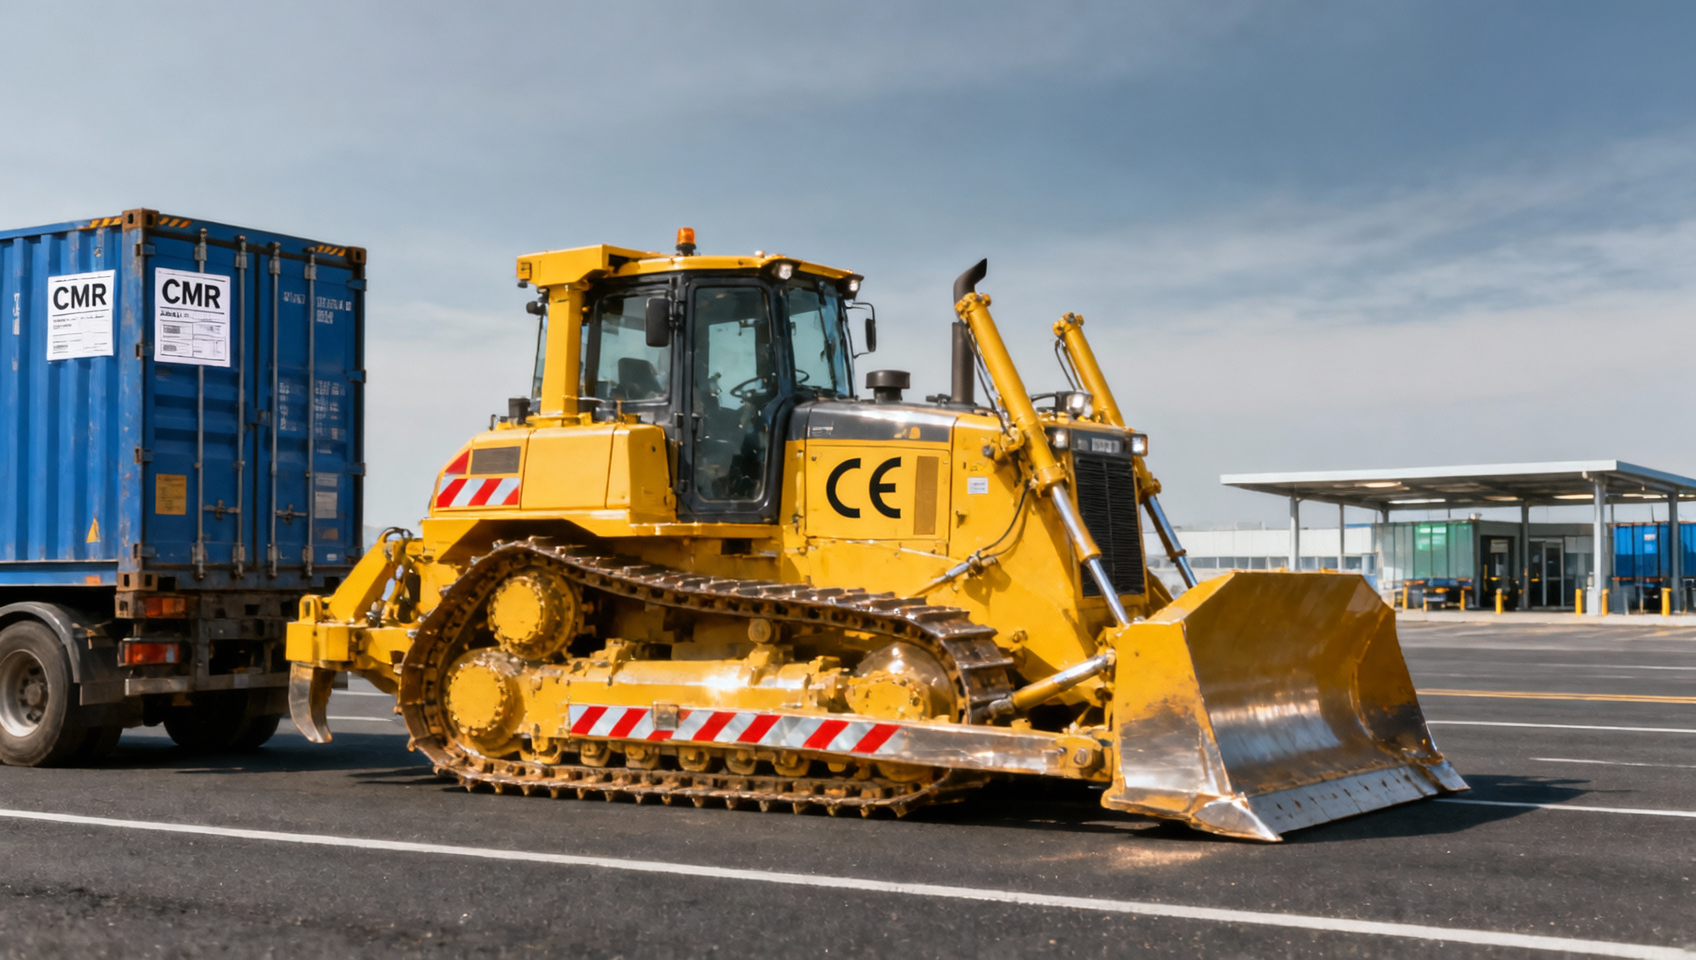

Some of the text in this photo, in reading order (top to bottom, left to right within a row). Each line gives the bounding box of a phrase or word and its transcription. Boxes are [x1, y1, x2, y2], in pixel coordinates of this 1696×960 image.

[53, 283, 107, 310] CMR
[162, 278, 221, 309] CMR
[826, 456, 901, 519] CE
